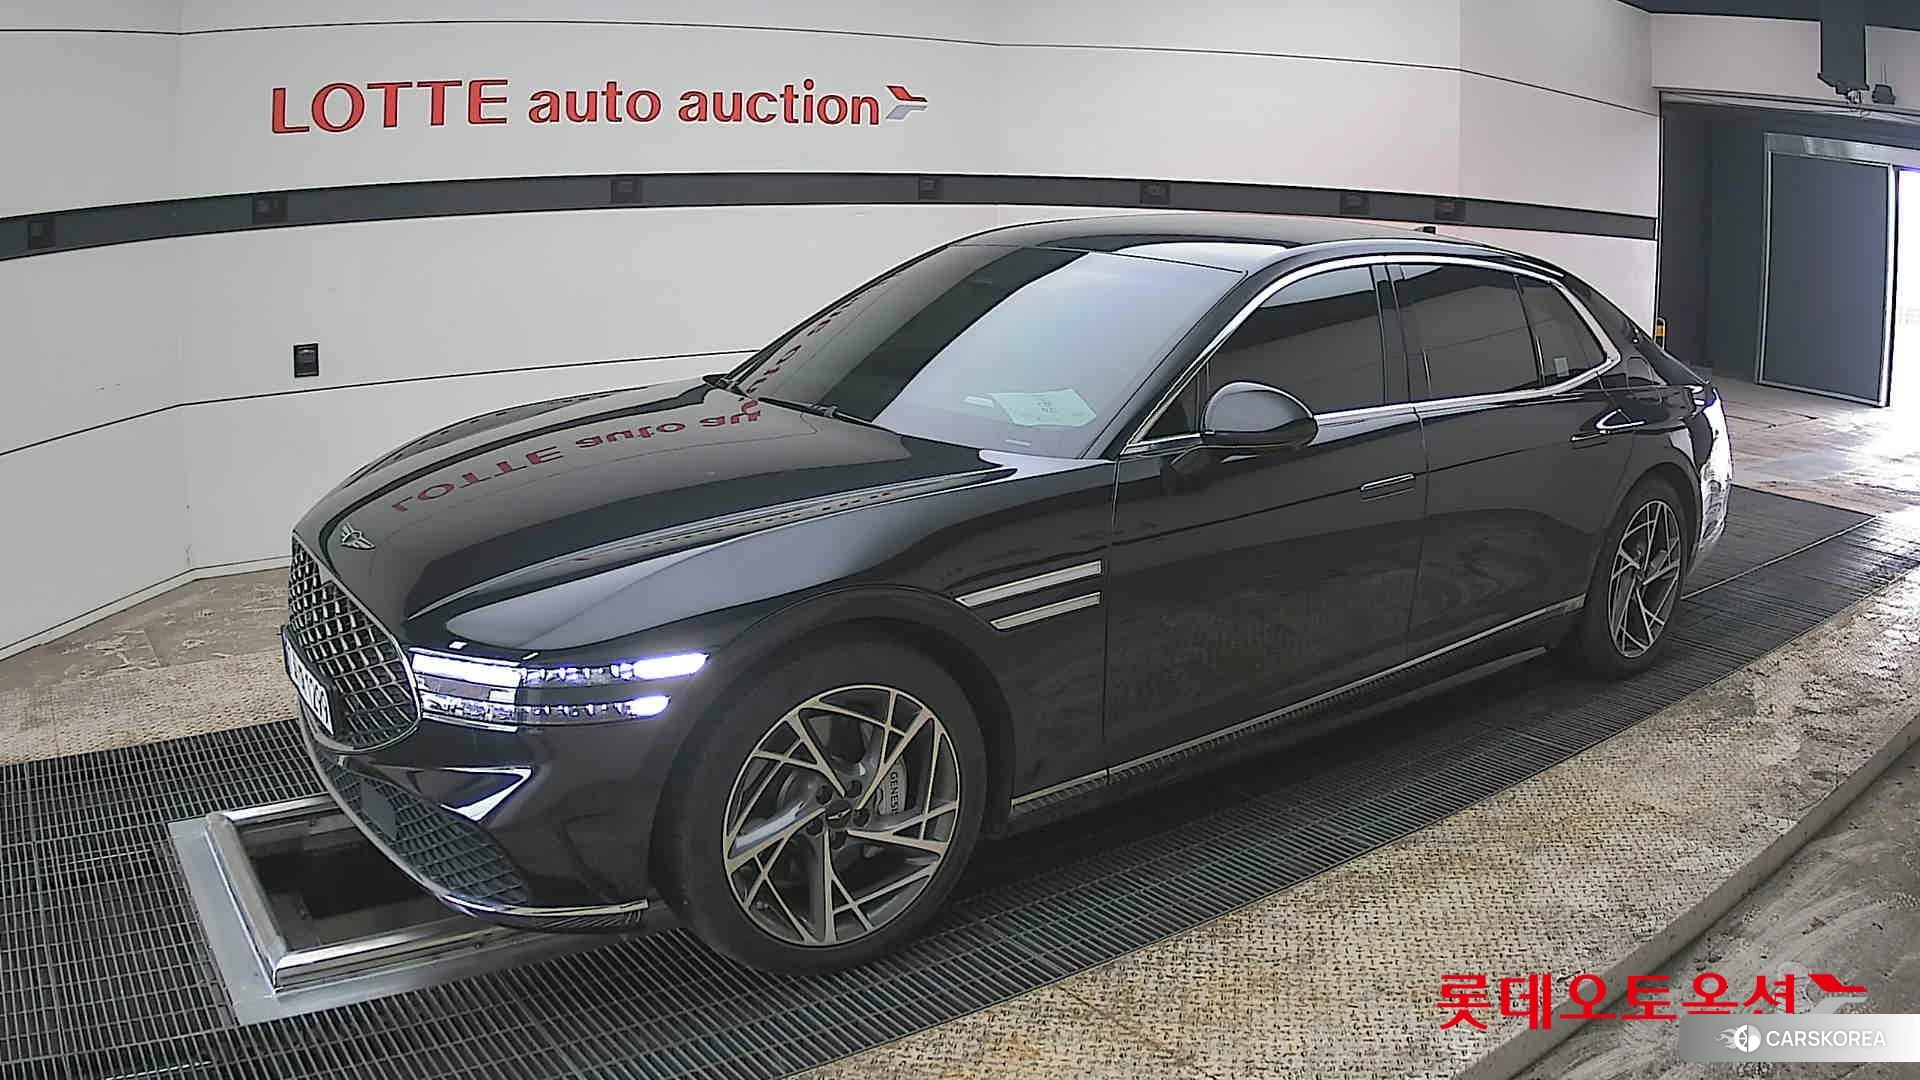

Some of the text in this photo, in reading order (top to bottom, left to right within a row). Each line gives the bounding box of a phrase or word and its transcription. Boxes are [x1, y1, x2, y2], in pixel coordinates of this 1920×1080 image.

[271, 78, 880, 135] LOTTE auto auction
